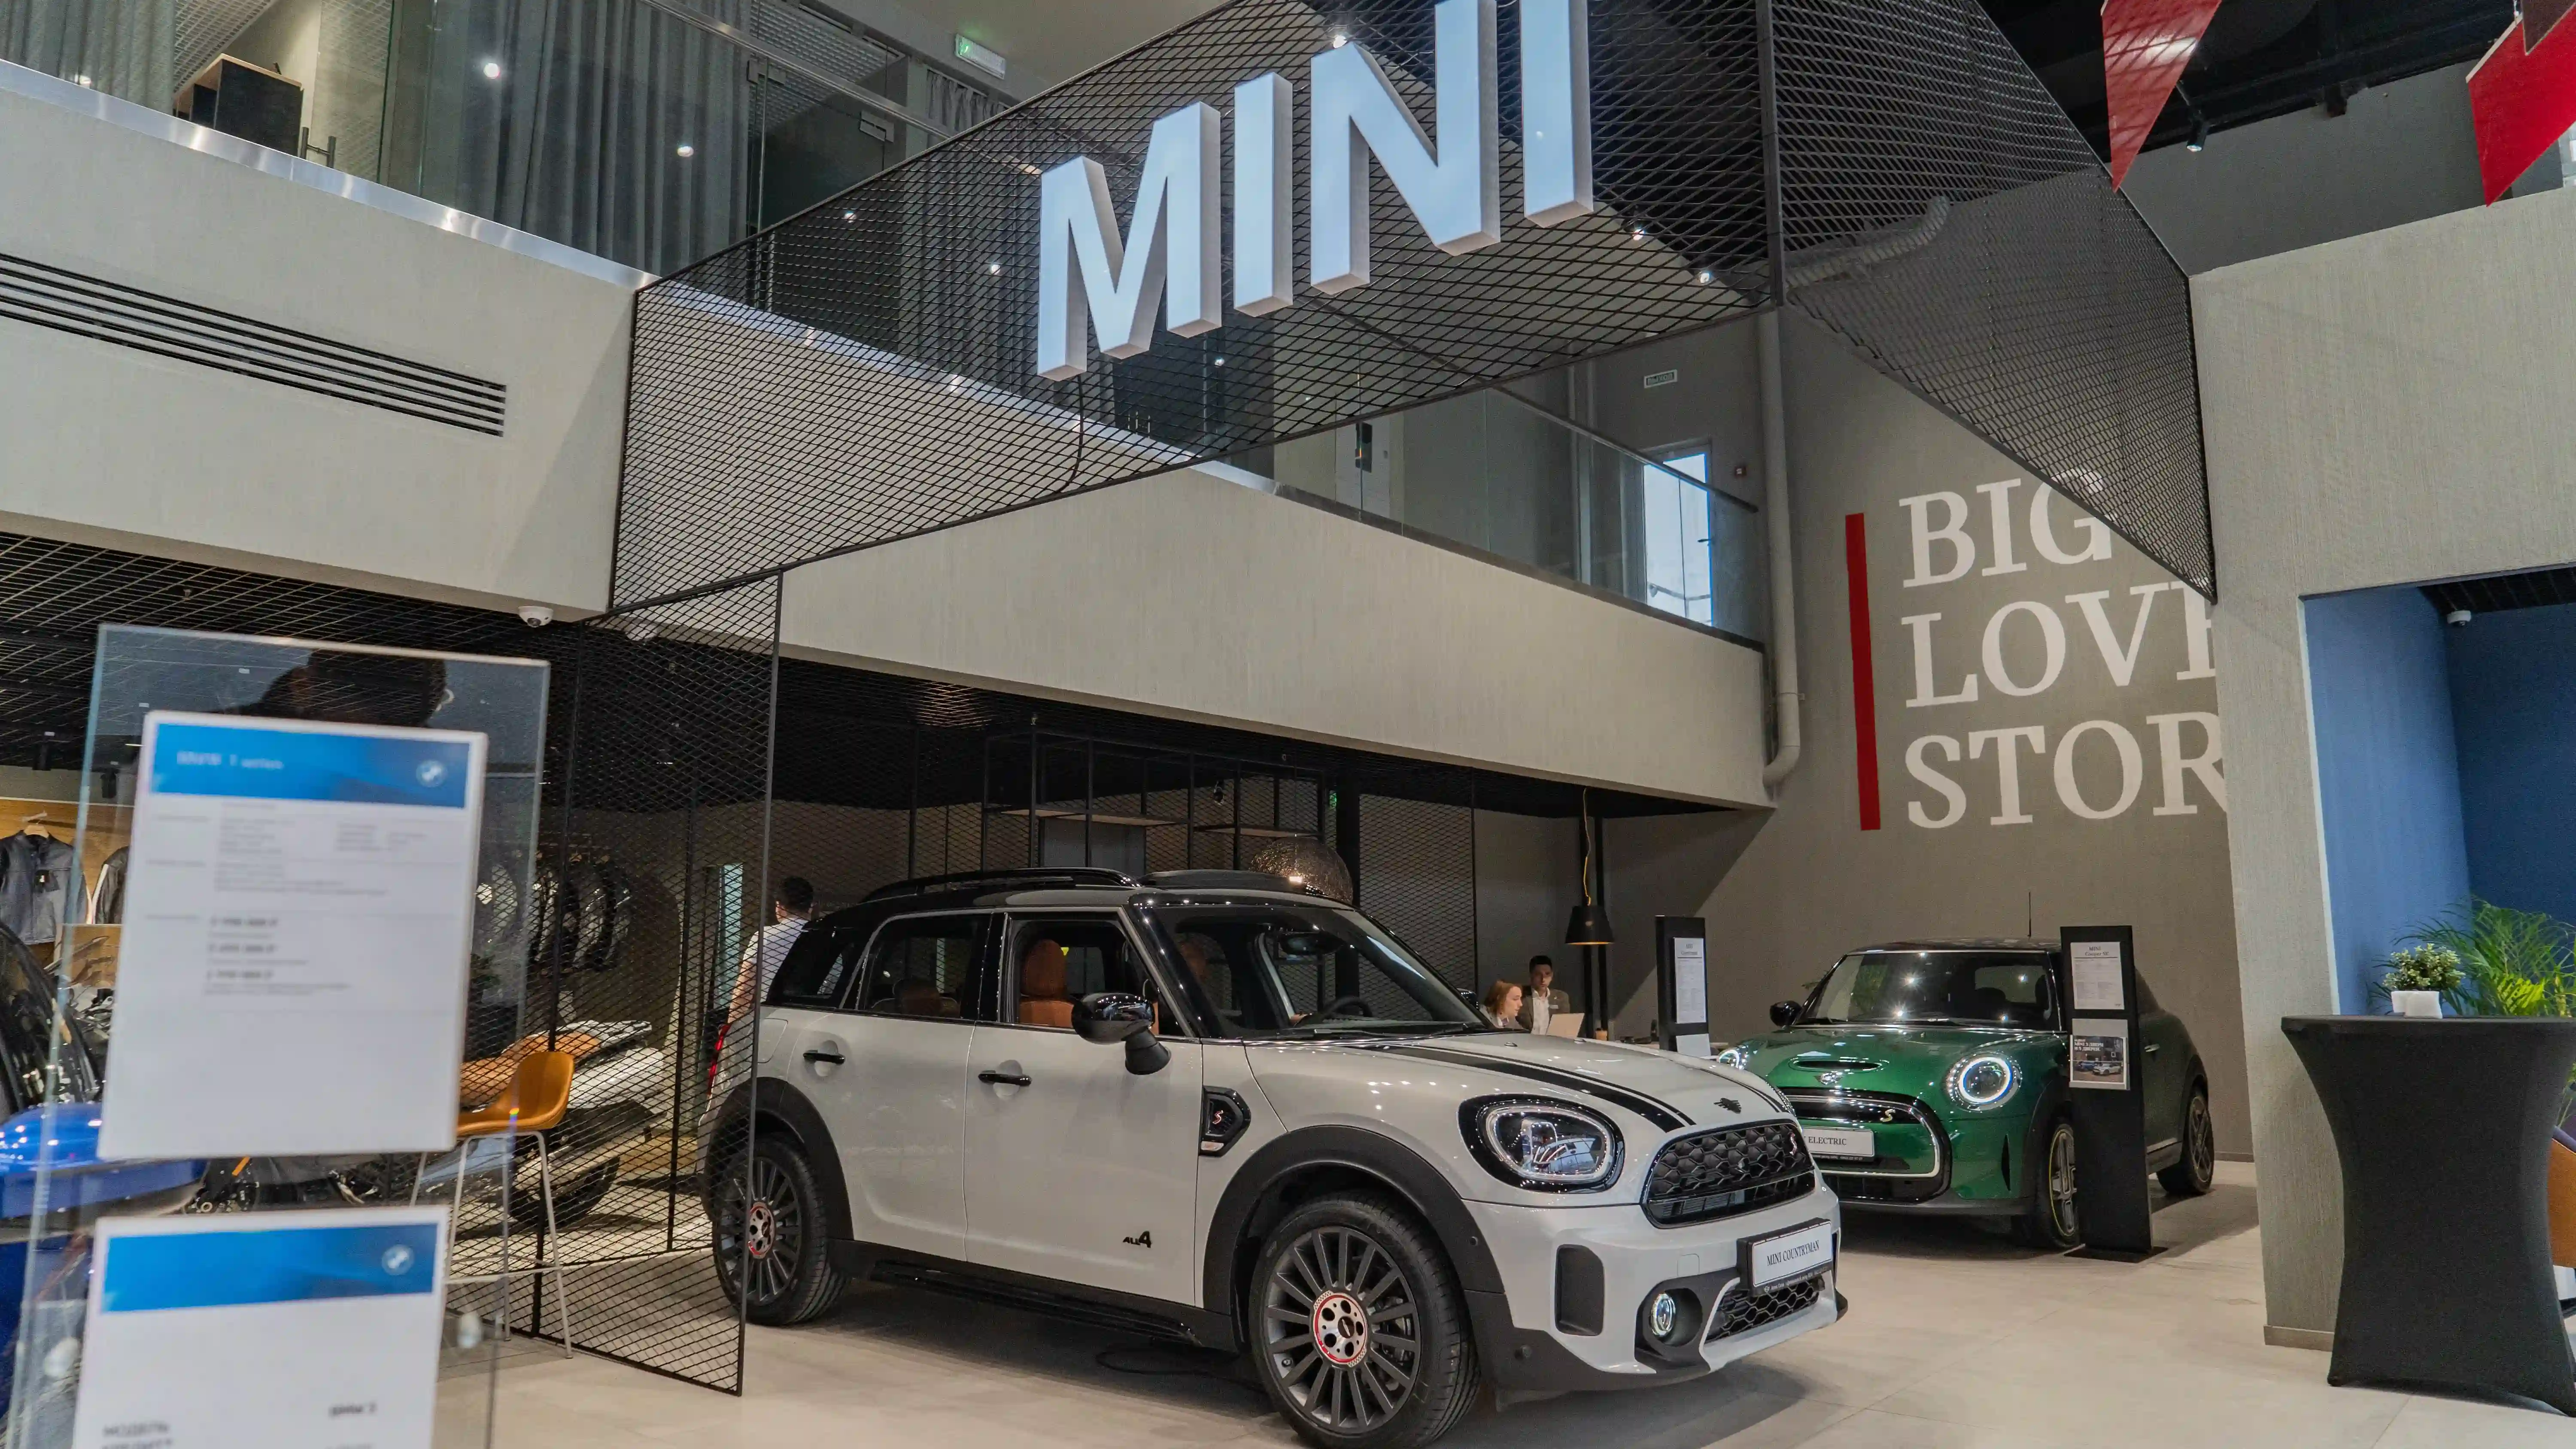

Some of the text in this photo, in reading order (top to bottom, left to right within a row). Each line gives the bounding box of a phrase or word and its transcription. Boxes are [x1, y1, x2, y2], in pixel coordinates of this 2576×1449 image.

[1037, 0, 1594, 381] MINI
[1899, 468, 2118, 588] BIG
[1808, 1137, 1847, 1145] ELECTRIC
[1767, 1240, 1819, 1266] MINI COUNTRYMAN
